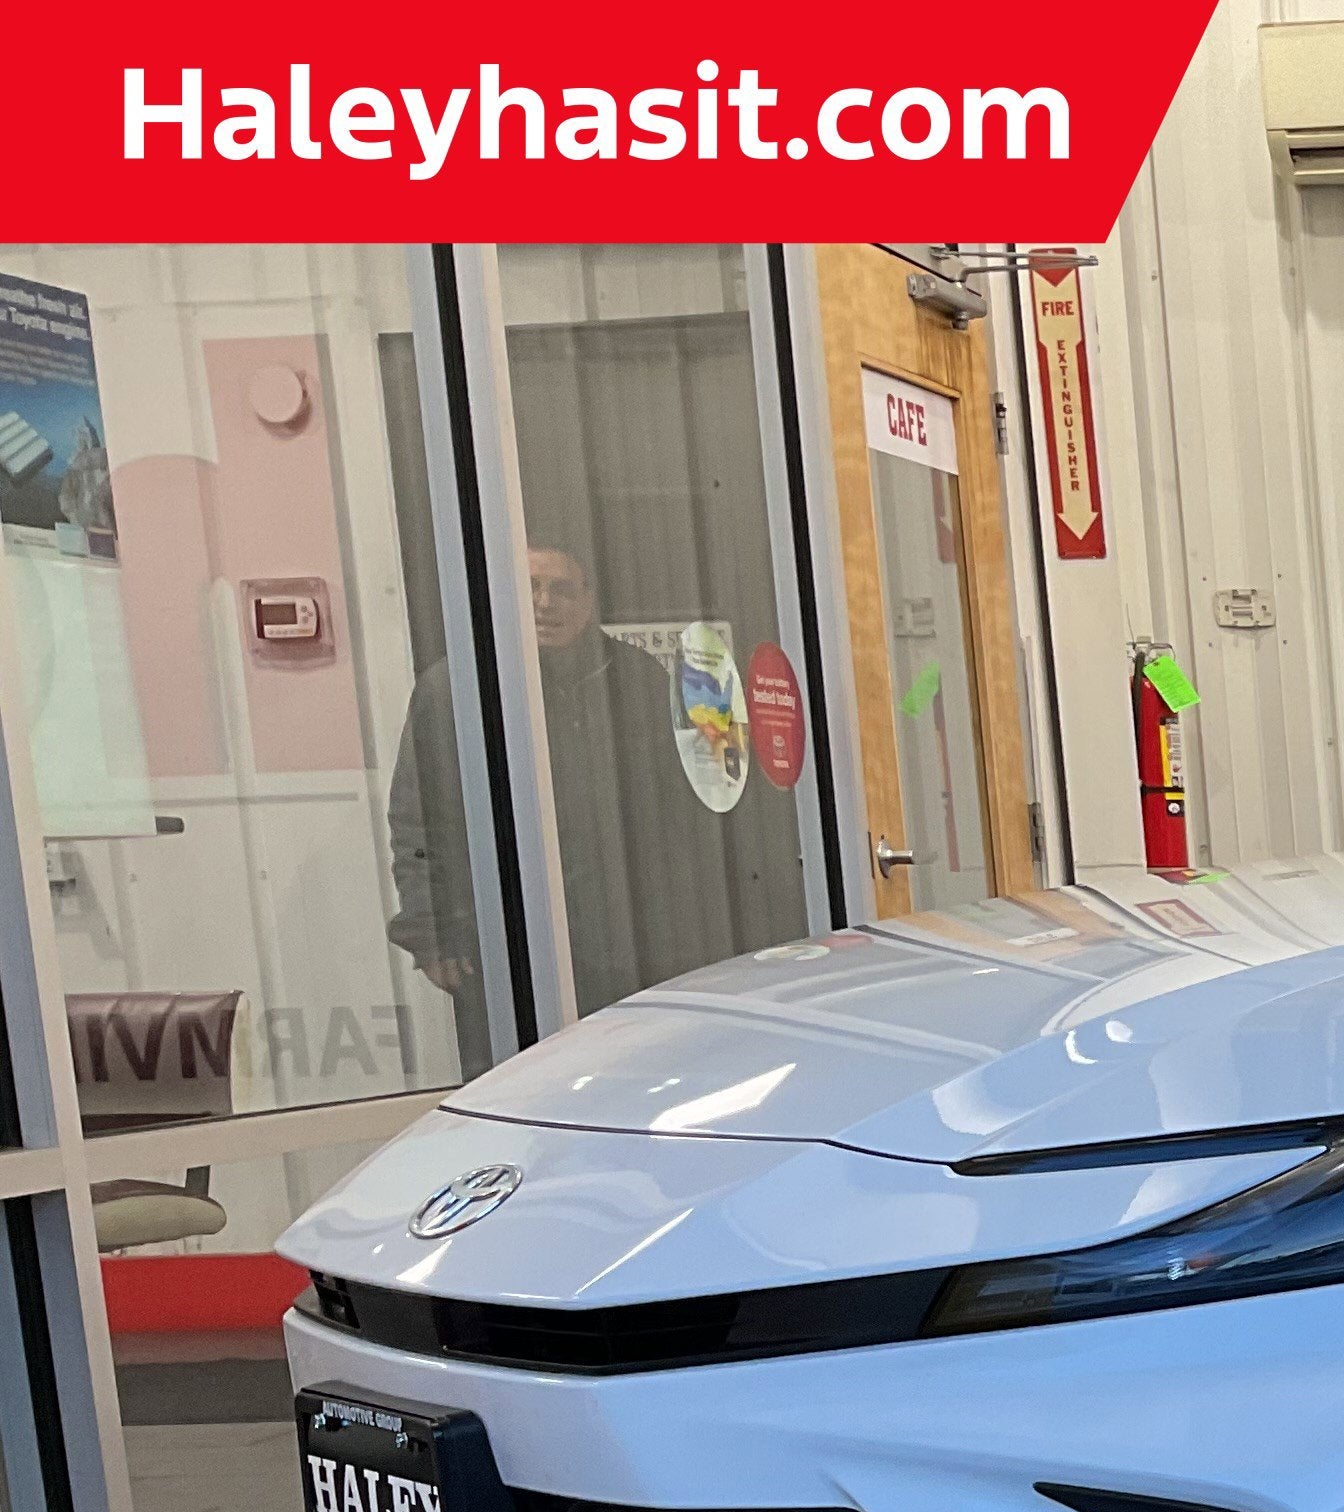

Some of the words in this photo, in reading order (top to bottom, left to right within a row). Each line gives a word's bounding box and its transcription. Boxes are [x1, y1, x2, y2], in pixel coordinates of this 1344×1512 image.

[1041, 300, 1075, 317] FIRE
[886, 393, 928, 447] CAFE
[1056, 339, 1081, 492] EXTINGUISHER
